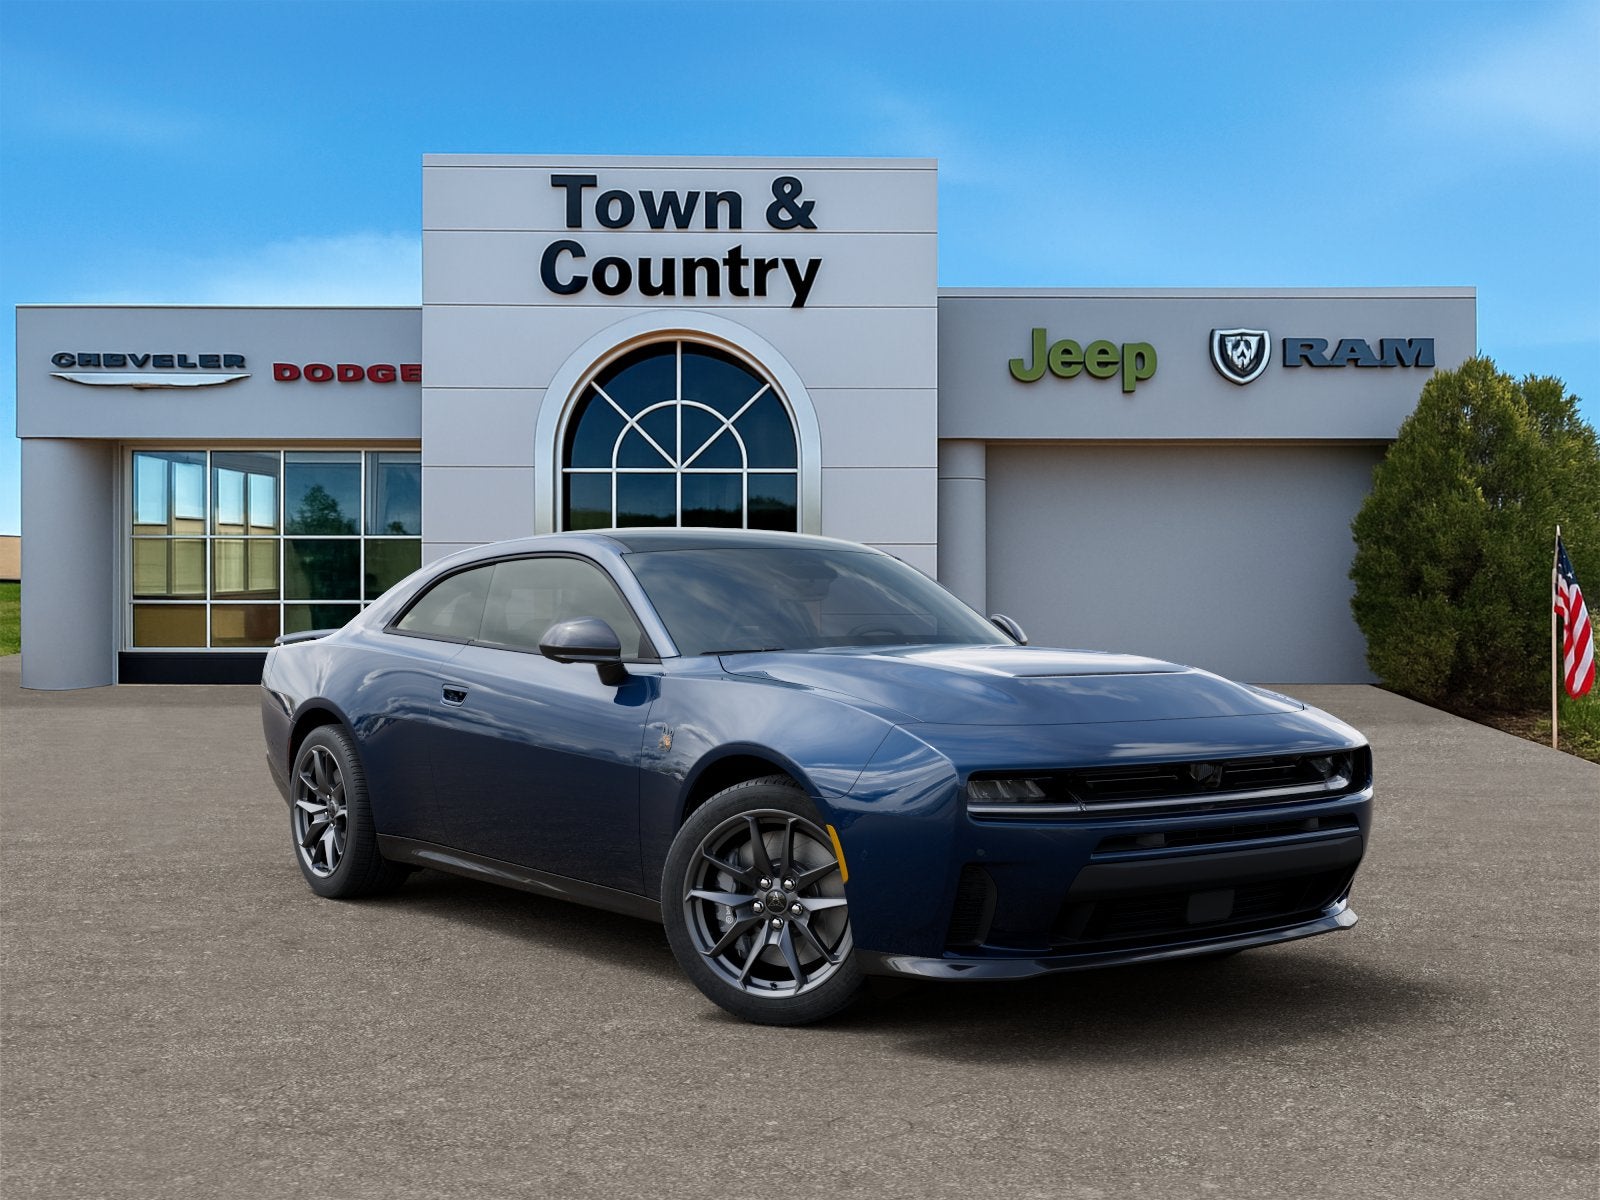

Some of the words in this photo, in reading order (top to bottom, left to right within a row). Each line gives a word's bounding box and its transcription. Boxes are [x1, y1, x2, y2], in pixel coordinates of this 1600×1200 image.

[551, 174, 742, 229] Town
[766, 176, 818, 230] &
[540, 239, 823, 308] Country
[273, 363, 422, 383] DODGE
[1009, 328, 1157, 391] Jeep
[1282, 337, 1435, 368] RAM
